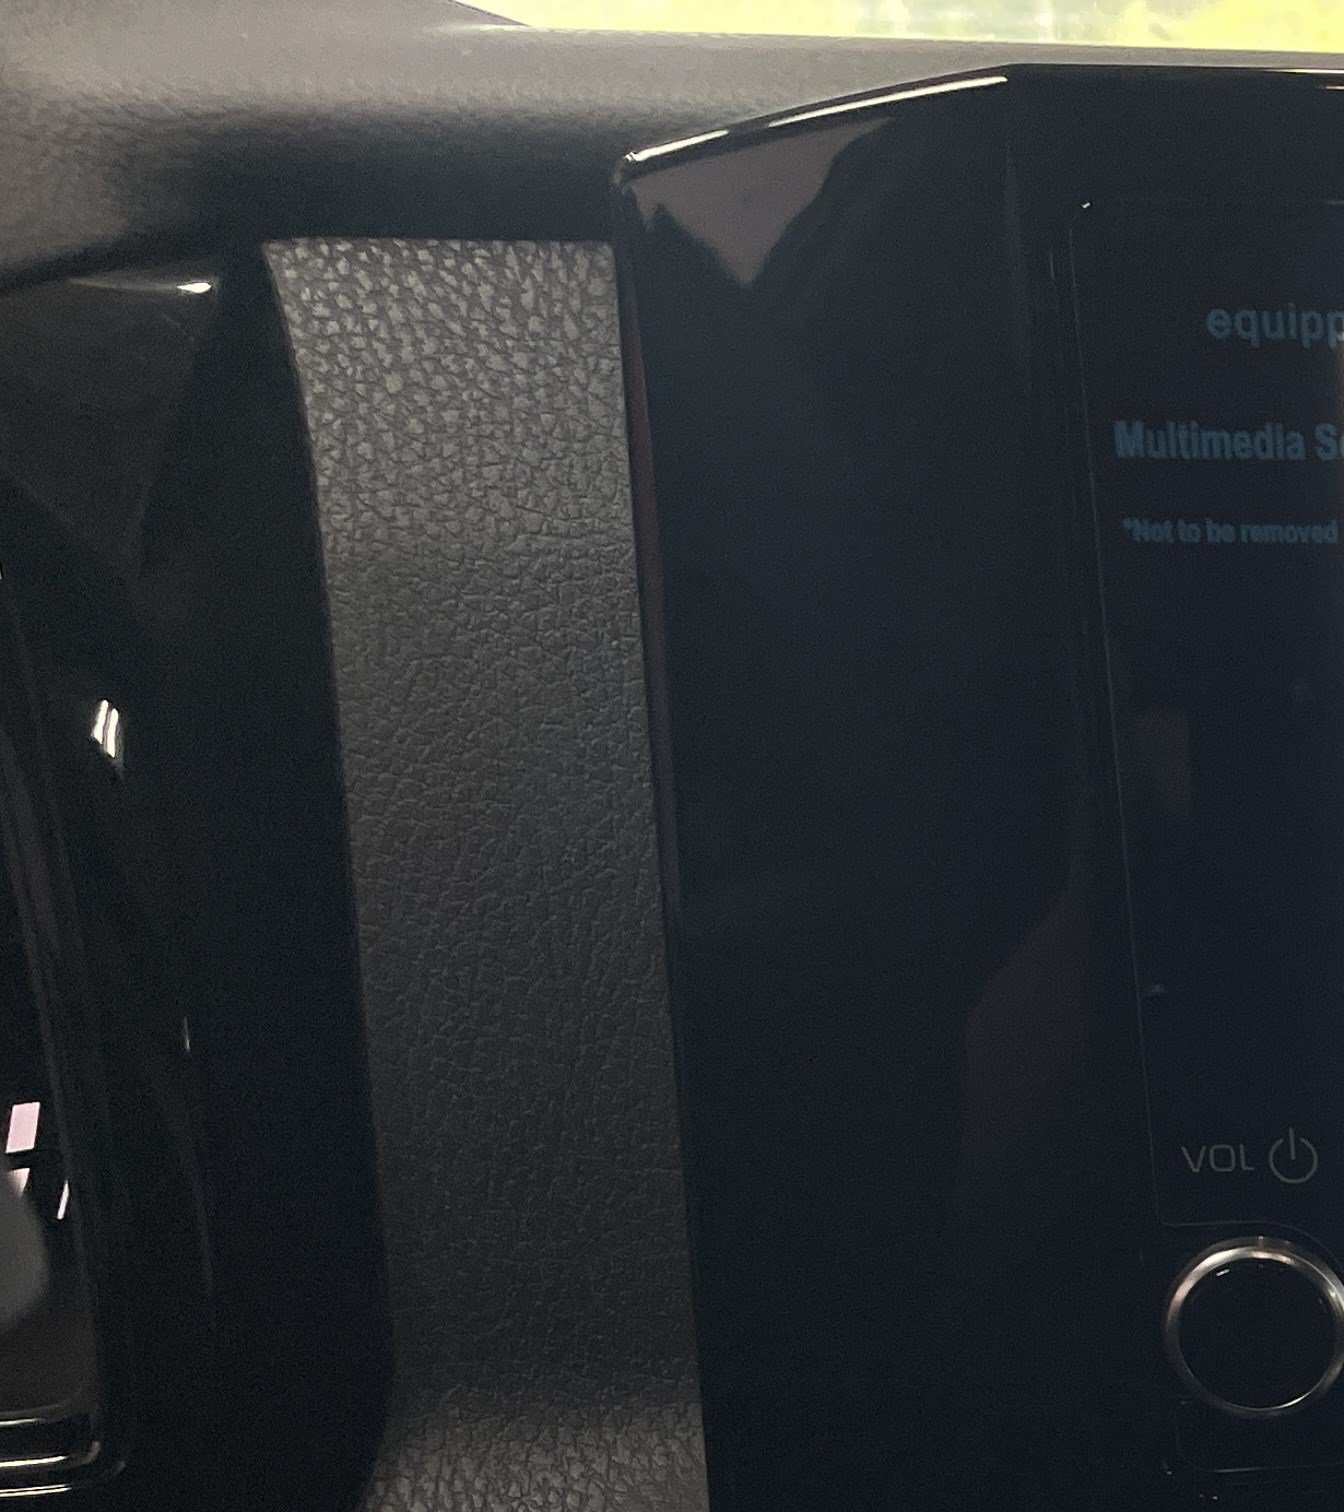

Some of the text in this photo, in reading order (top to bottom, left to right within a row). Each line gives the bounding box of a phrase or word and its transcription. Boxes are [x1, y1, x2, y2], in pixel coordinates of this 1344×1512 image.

[1113, 419, 1306, 461] Multimedia
[1239, 518, 1340, 546] removed
[1181, 1144, 1255, 1173] VOL
